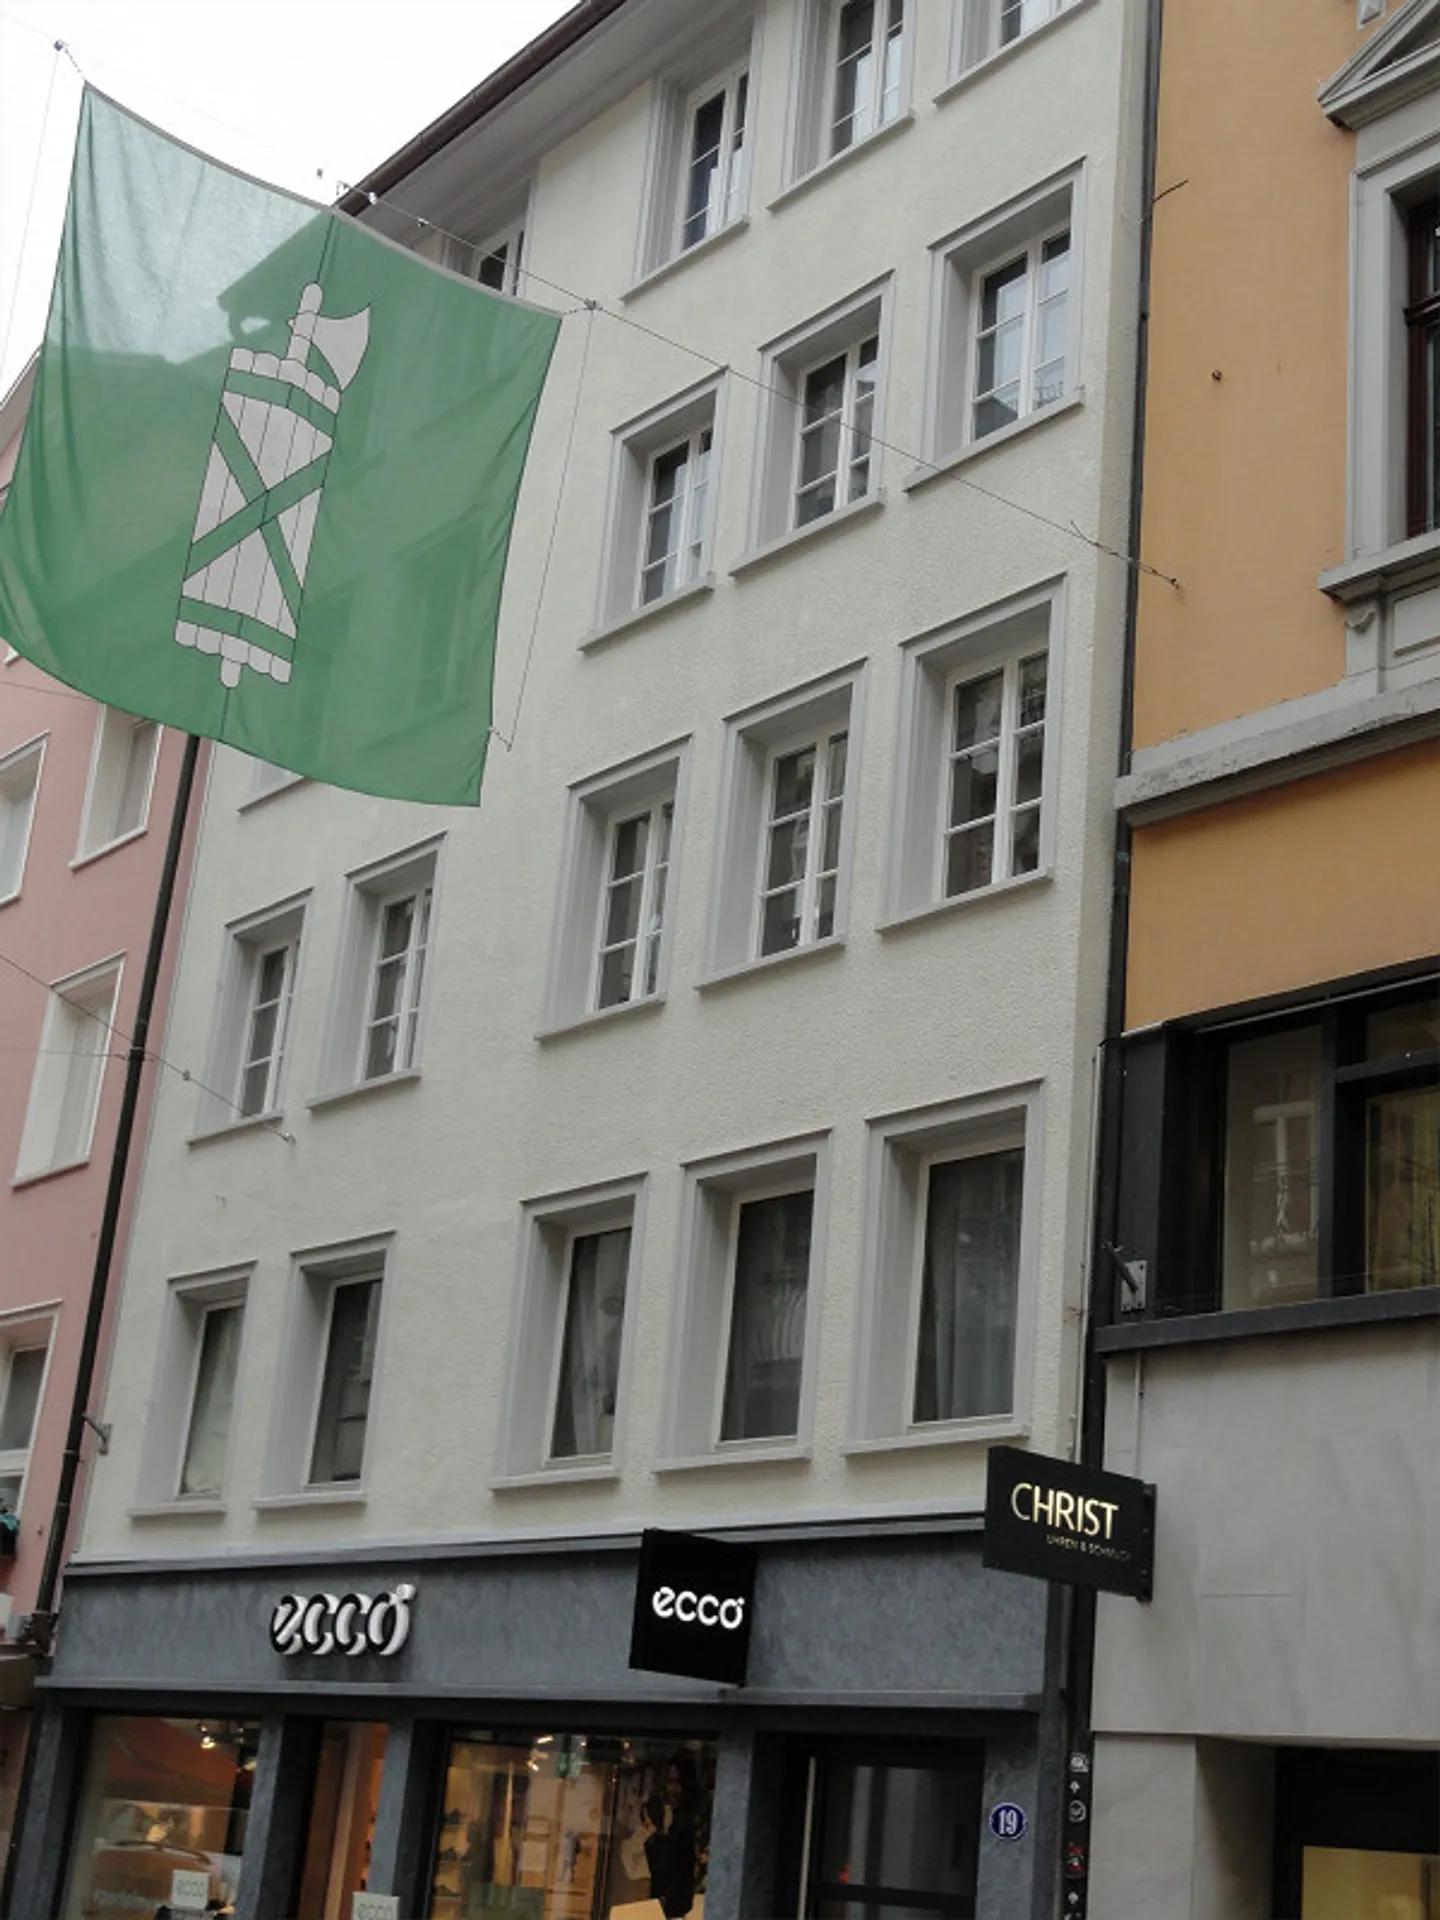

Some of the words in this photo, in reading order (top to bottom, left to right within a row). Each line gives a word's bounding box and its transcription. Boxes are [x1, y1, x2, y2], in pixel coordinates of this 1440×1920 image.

[1011, 1482, 1119, 1540] CHRIST
[270, 1583, 416, 1656] ecco
[652, 1586, 746, 1630] ecco
[998, 1809, 1018, 1835] 19
